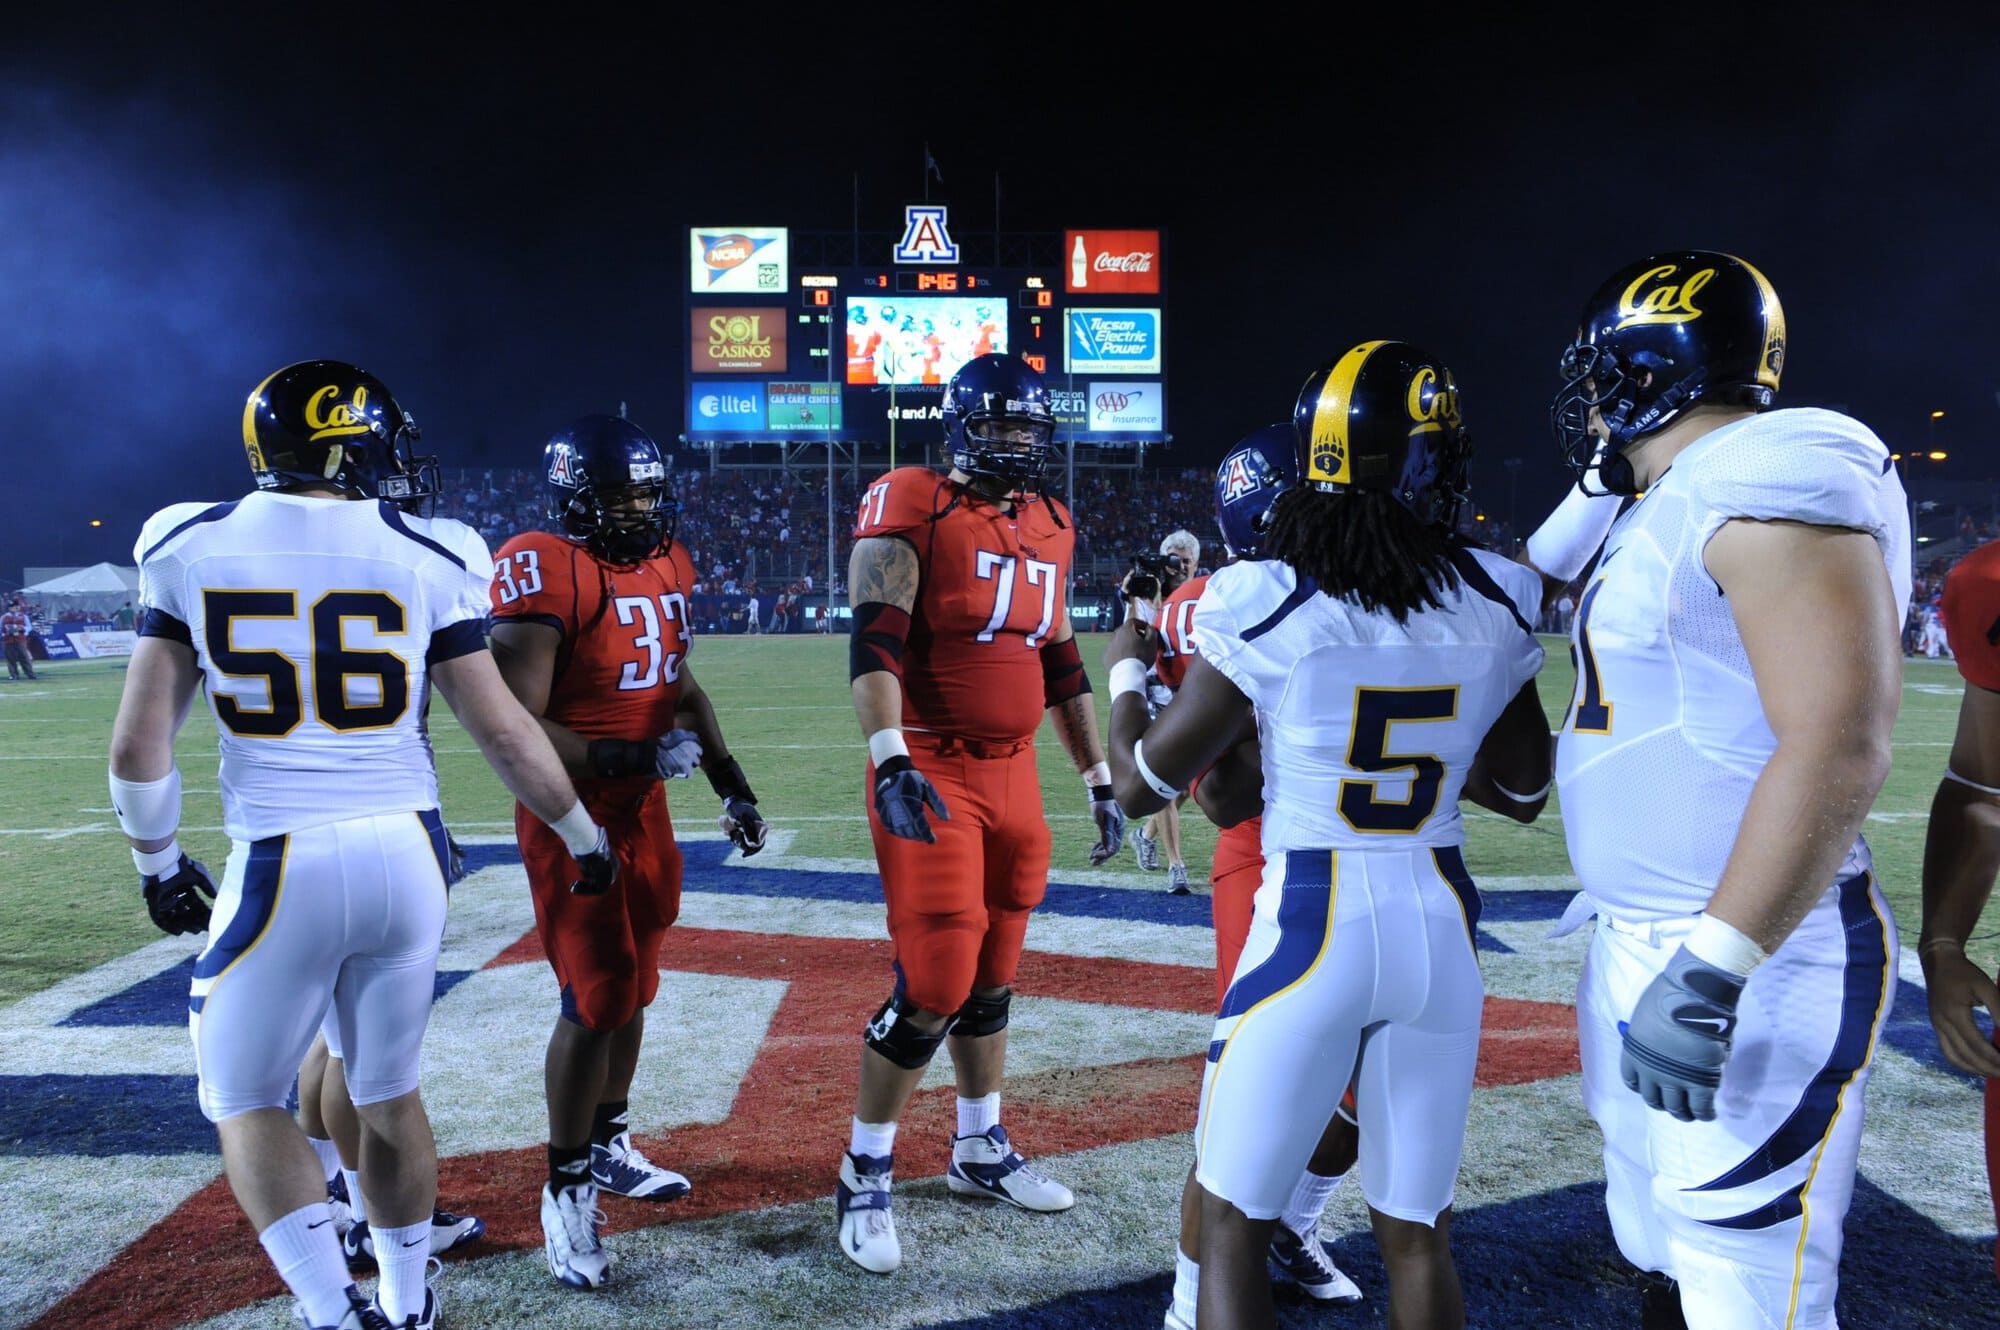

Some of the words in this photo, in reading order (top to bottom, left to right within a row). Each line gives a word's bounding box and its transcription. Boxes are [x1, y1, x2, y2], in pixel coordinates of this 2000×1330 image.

[893, 206, 960, 264] A
[711, 247, 748, 262] NCAA
[878, 275, 888, 288] 3
[918, 272, 958, 291] 1:46
[967, 275, 976, 288] 3
[814, 289, 829, 306] 0
[1037, 291, 1052, 306] 0
[1615, 264, 1715, 332] Cal
[709, 315, 771, 344] SOL
[1090, 317, 1136, 331] Tucson
[1095, 330, 1148, 342] Electric
[708, 344, 772, 358] CASINOS
[1100, 342, 1147, 354] Power
[699, 394, 758, 417] alltel
[770, 395, 786, 404] CAR
[787, 395, 806, 404] CARE
[1098, 393, 1126, 412] AAA
[304, 384, 370, 442] Cal
[902, 406, 927, 420] and
[1112, 415, 1157, 424] Insurance
[1221, 446, 1261, 507] A
[860, 480, 893, 532] 77
[494, 549, 543, 605] 33
[975, 549, 1058, 649] 77
[614, 591, 695, 692] 33
[201, 588, 411, 739] 56
[1335, 683, 1461, 836] 5
